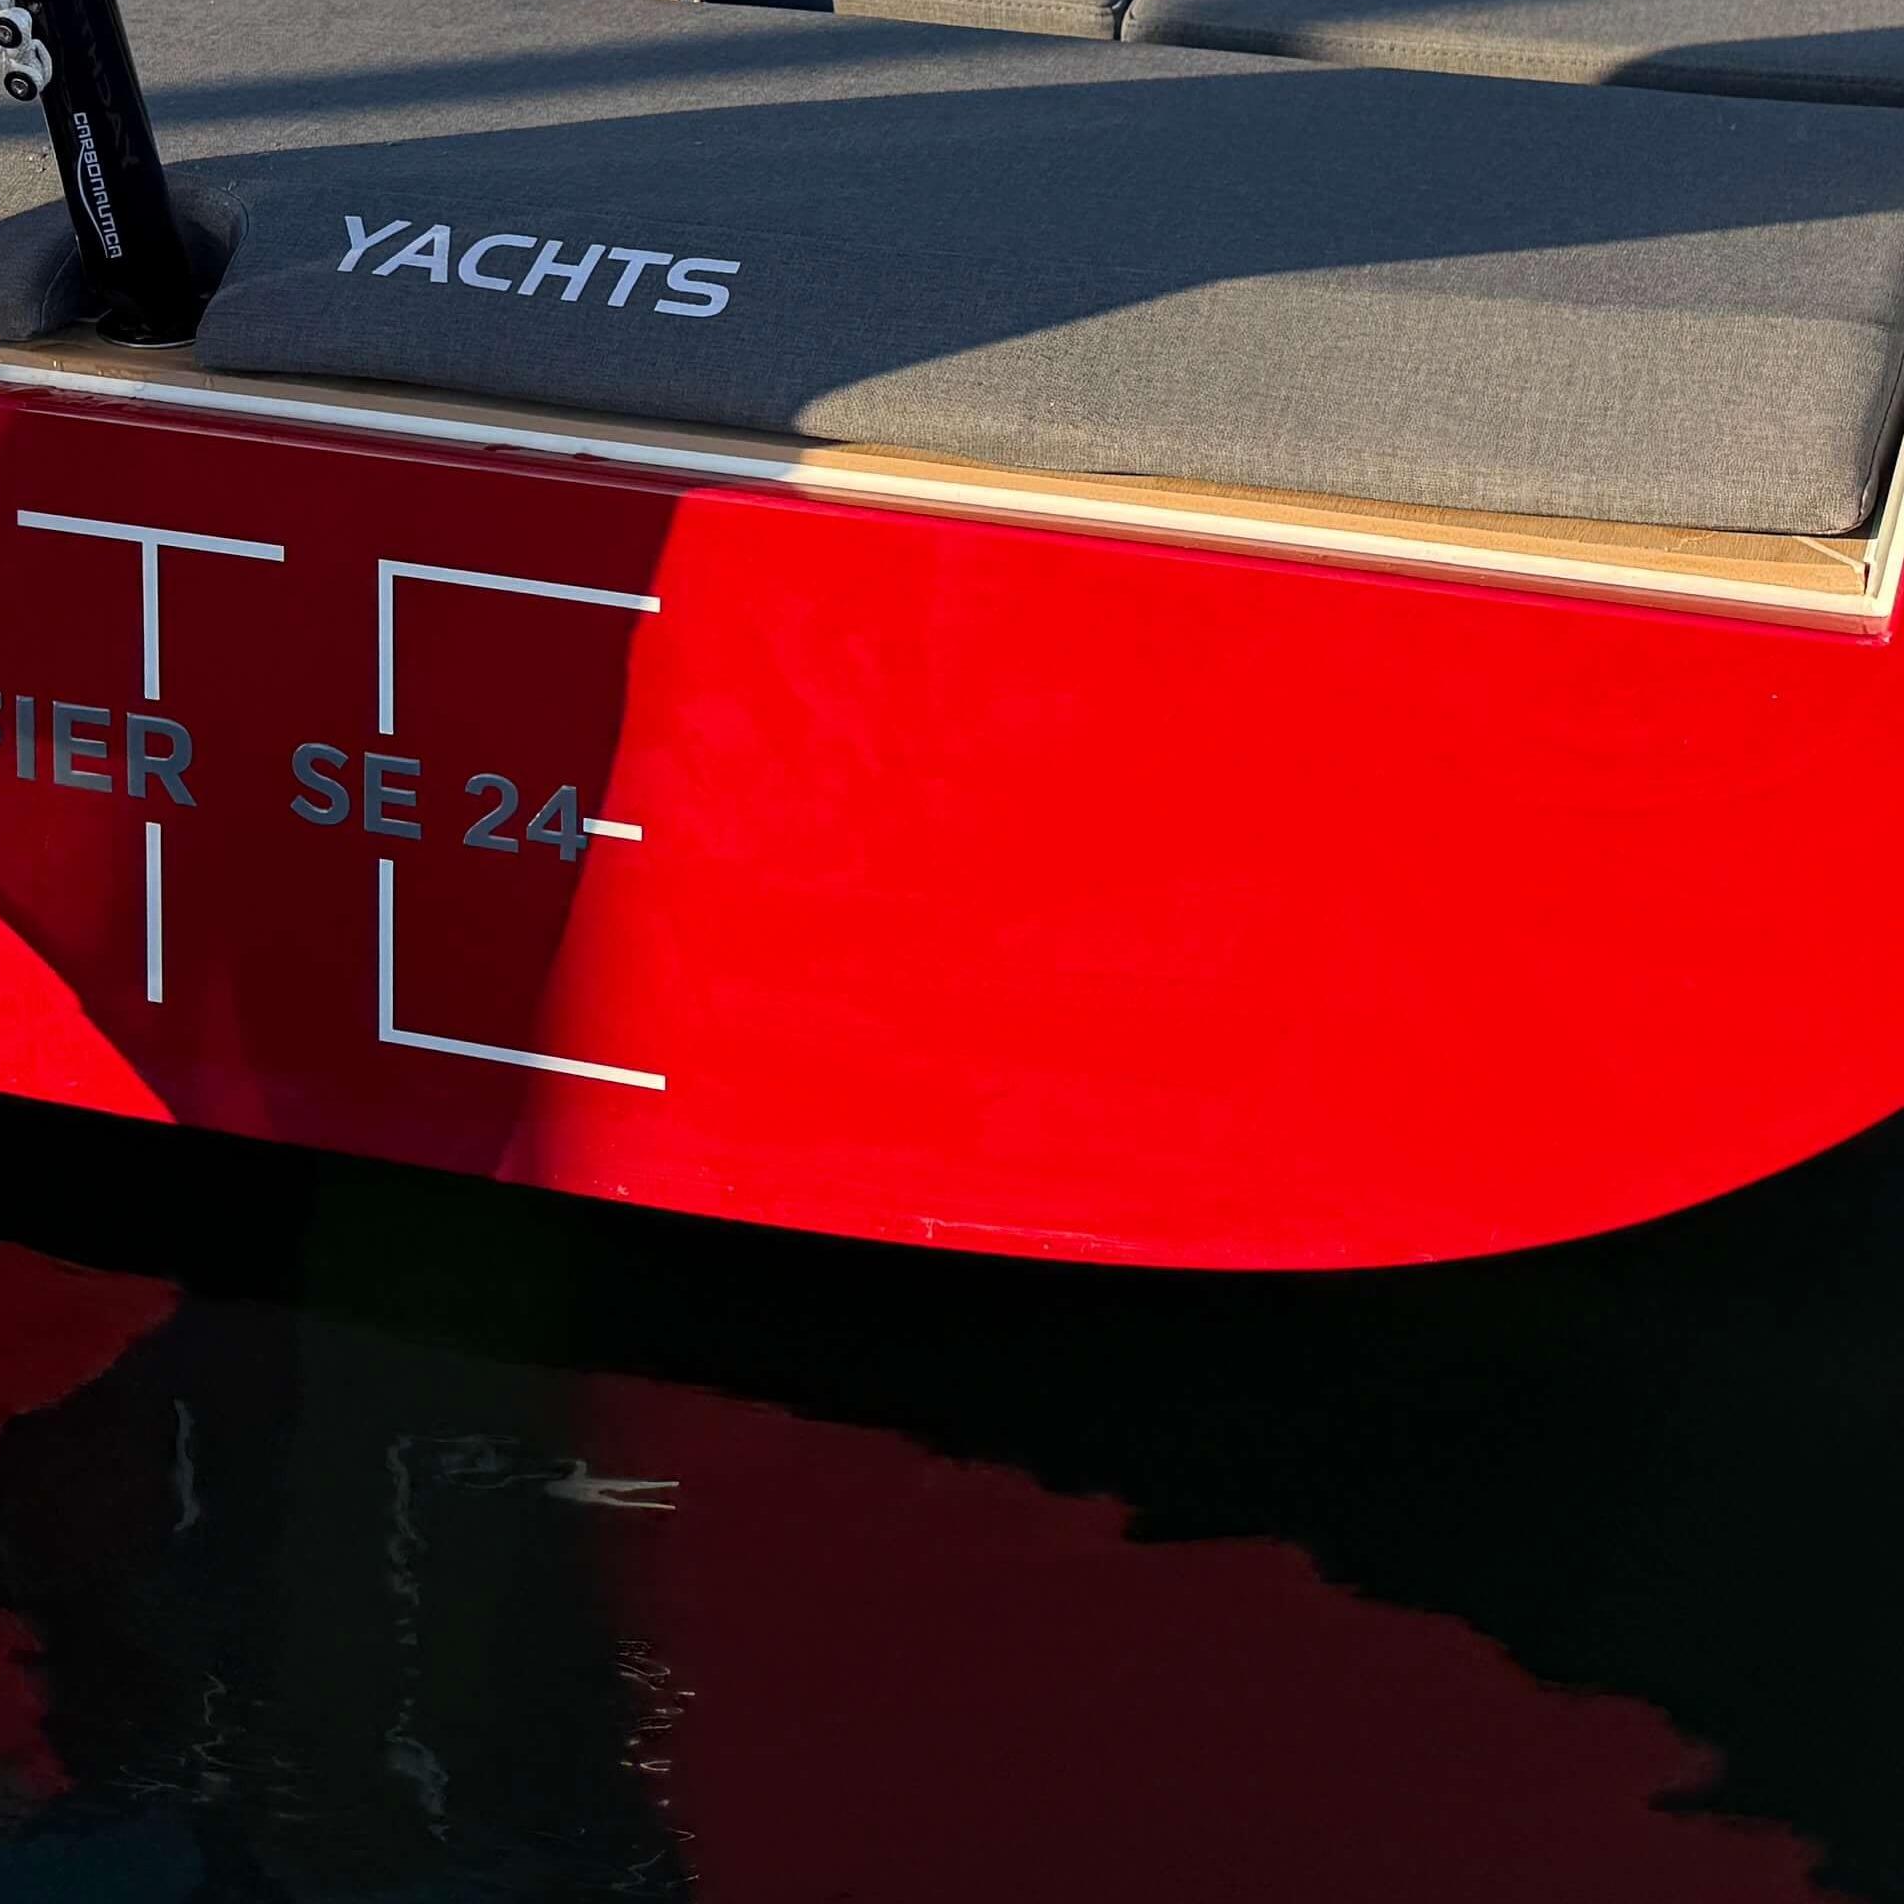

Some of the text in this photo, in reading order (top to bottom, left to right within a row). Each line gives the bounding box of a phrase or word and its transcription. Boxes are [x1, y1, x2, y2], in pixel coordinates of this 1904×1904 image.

[73, 112, 122, 259] CARBONAUTICA
[336, 215, 741, 317] YACHTS
[290, 742, 422, 840] SE
[463, 773, 588, 862] 24
